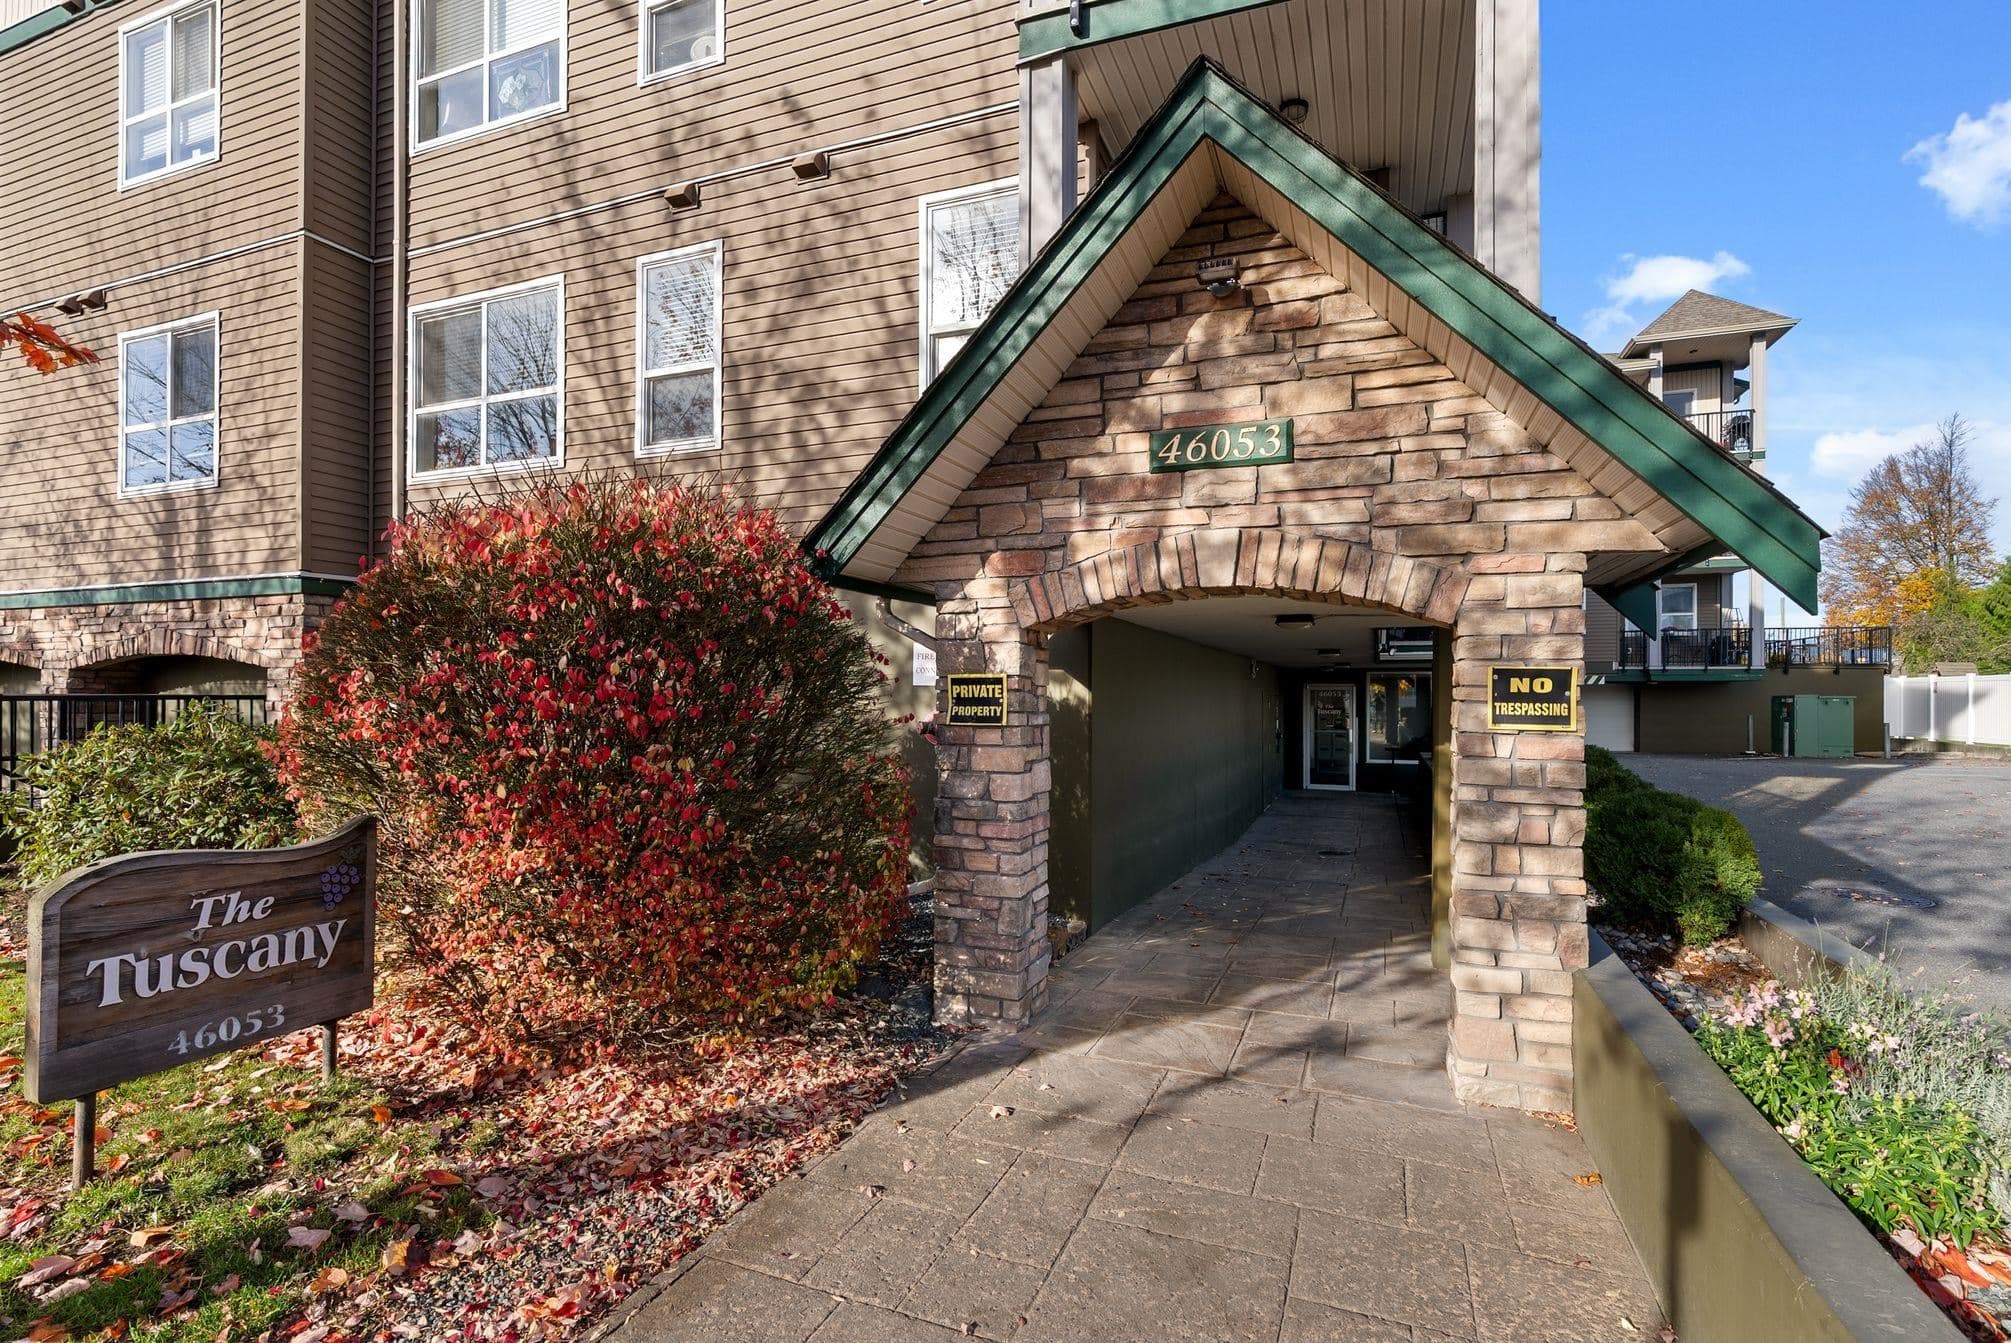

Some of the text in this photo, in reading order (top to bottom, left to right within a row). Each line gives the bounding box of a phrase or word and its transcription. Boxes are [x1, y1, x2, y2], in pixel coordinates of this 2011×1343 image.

[1158, 424, 1281, 464] 46053
[917, 652, 936, 660] FIRE
[952, 685, 1002, 698] PRIVATE
[1510, 677, 1553, 694] NO
[952, 706, 1002, 717] PROPERTY
[1494, 702, 1569, 716] TRESPASSING
[190, 890, 275, 931] The
[85, 918, 348, 1009] Tuscany
[167, 1004, 286, 1055] 46053
